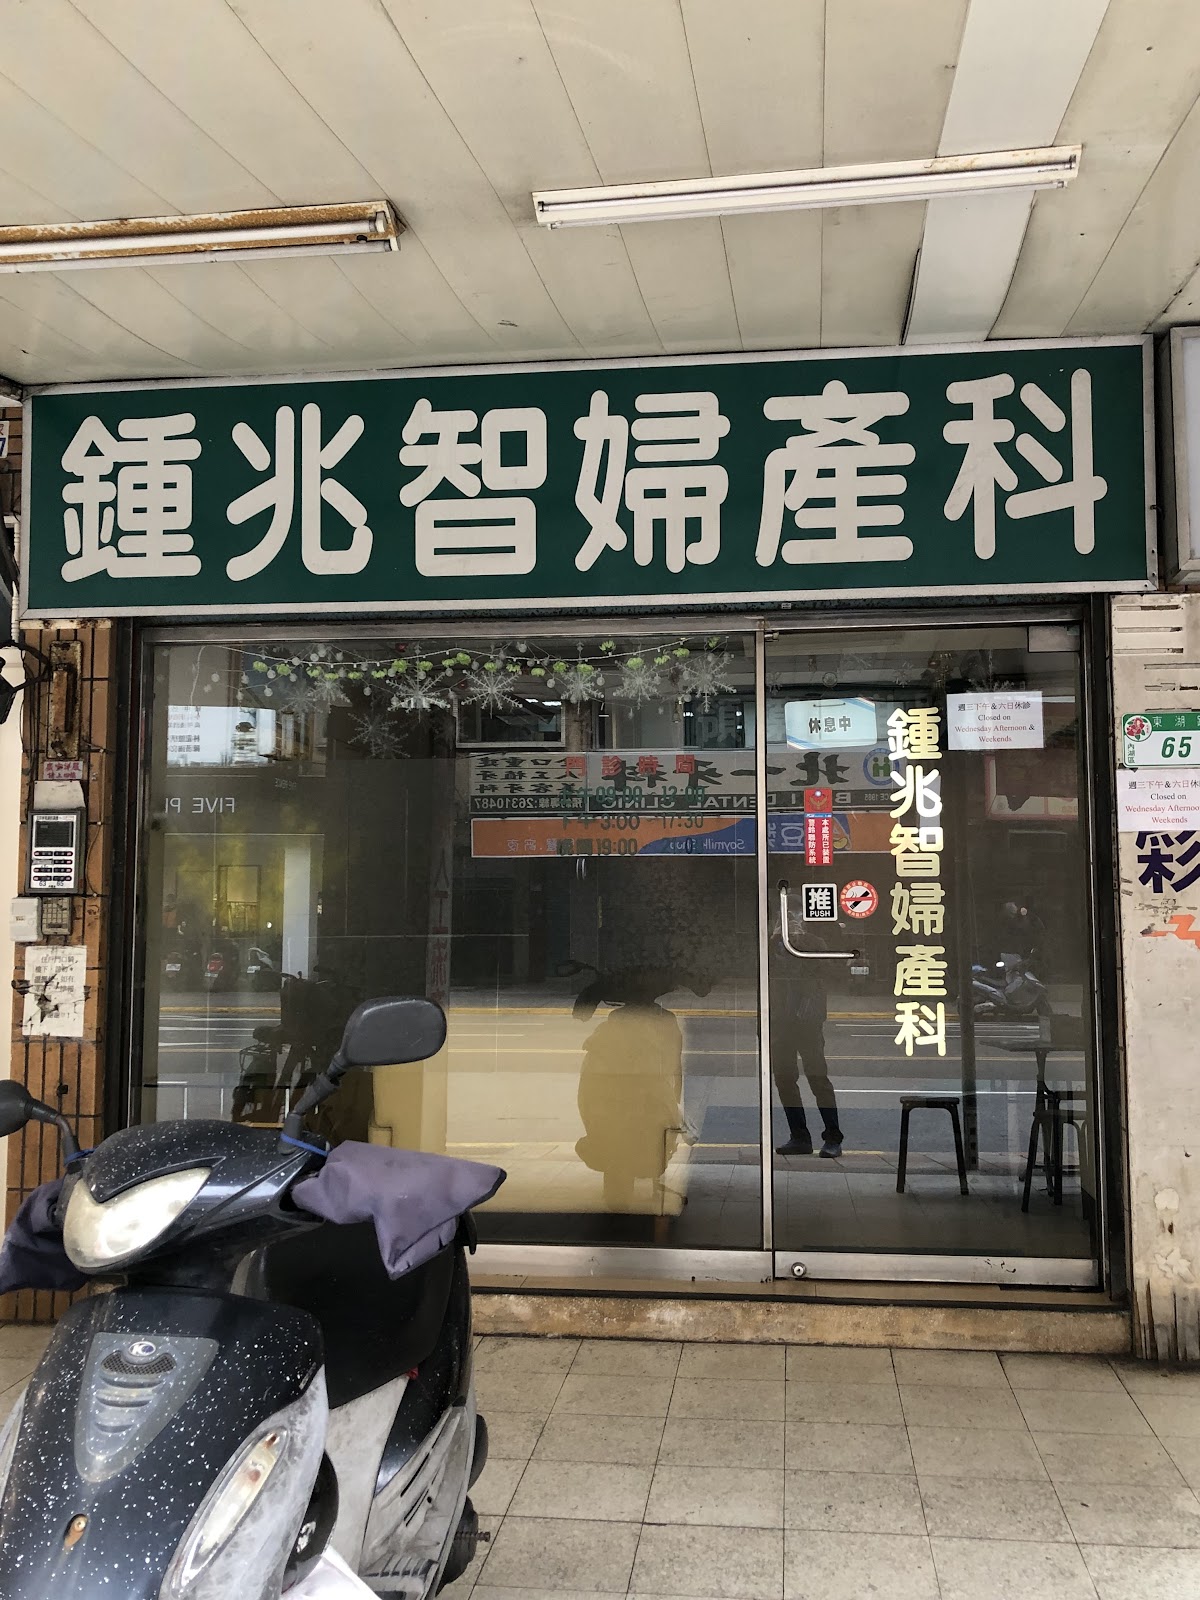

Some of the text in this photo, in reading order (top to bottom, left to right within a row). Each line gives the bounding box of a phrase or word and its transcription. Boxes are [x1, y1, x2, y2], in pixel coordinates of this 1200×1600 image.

[61, 368, 1108, 583] 鍾兆智婦產科
[977, 713, 1001, 721] Closed
[808, 715, 851, 734] 休息中
[954, 723, 1036, 733] Wednesday Afternoon &
[978, 735, 1013, 743] Weekends
[1161, 736, 1192, 759] 65
[1128, 779, 1200, 790] 週三下午&六日休
[1150, 792, 1176, 801] Closed
[1125, 803, 1200, 813] Wednesday Afternoo
[1151, 815, 1188, 824] Weekends
[886, 706, 948, 1057] 鍾兆智婦產科
[808, 887, 832, 910] 推
